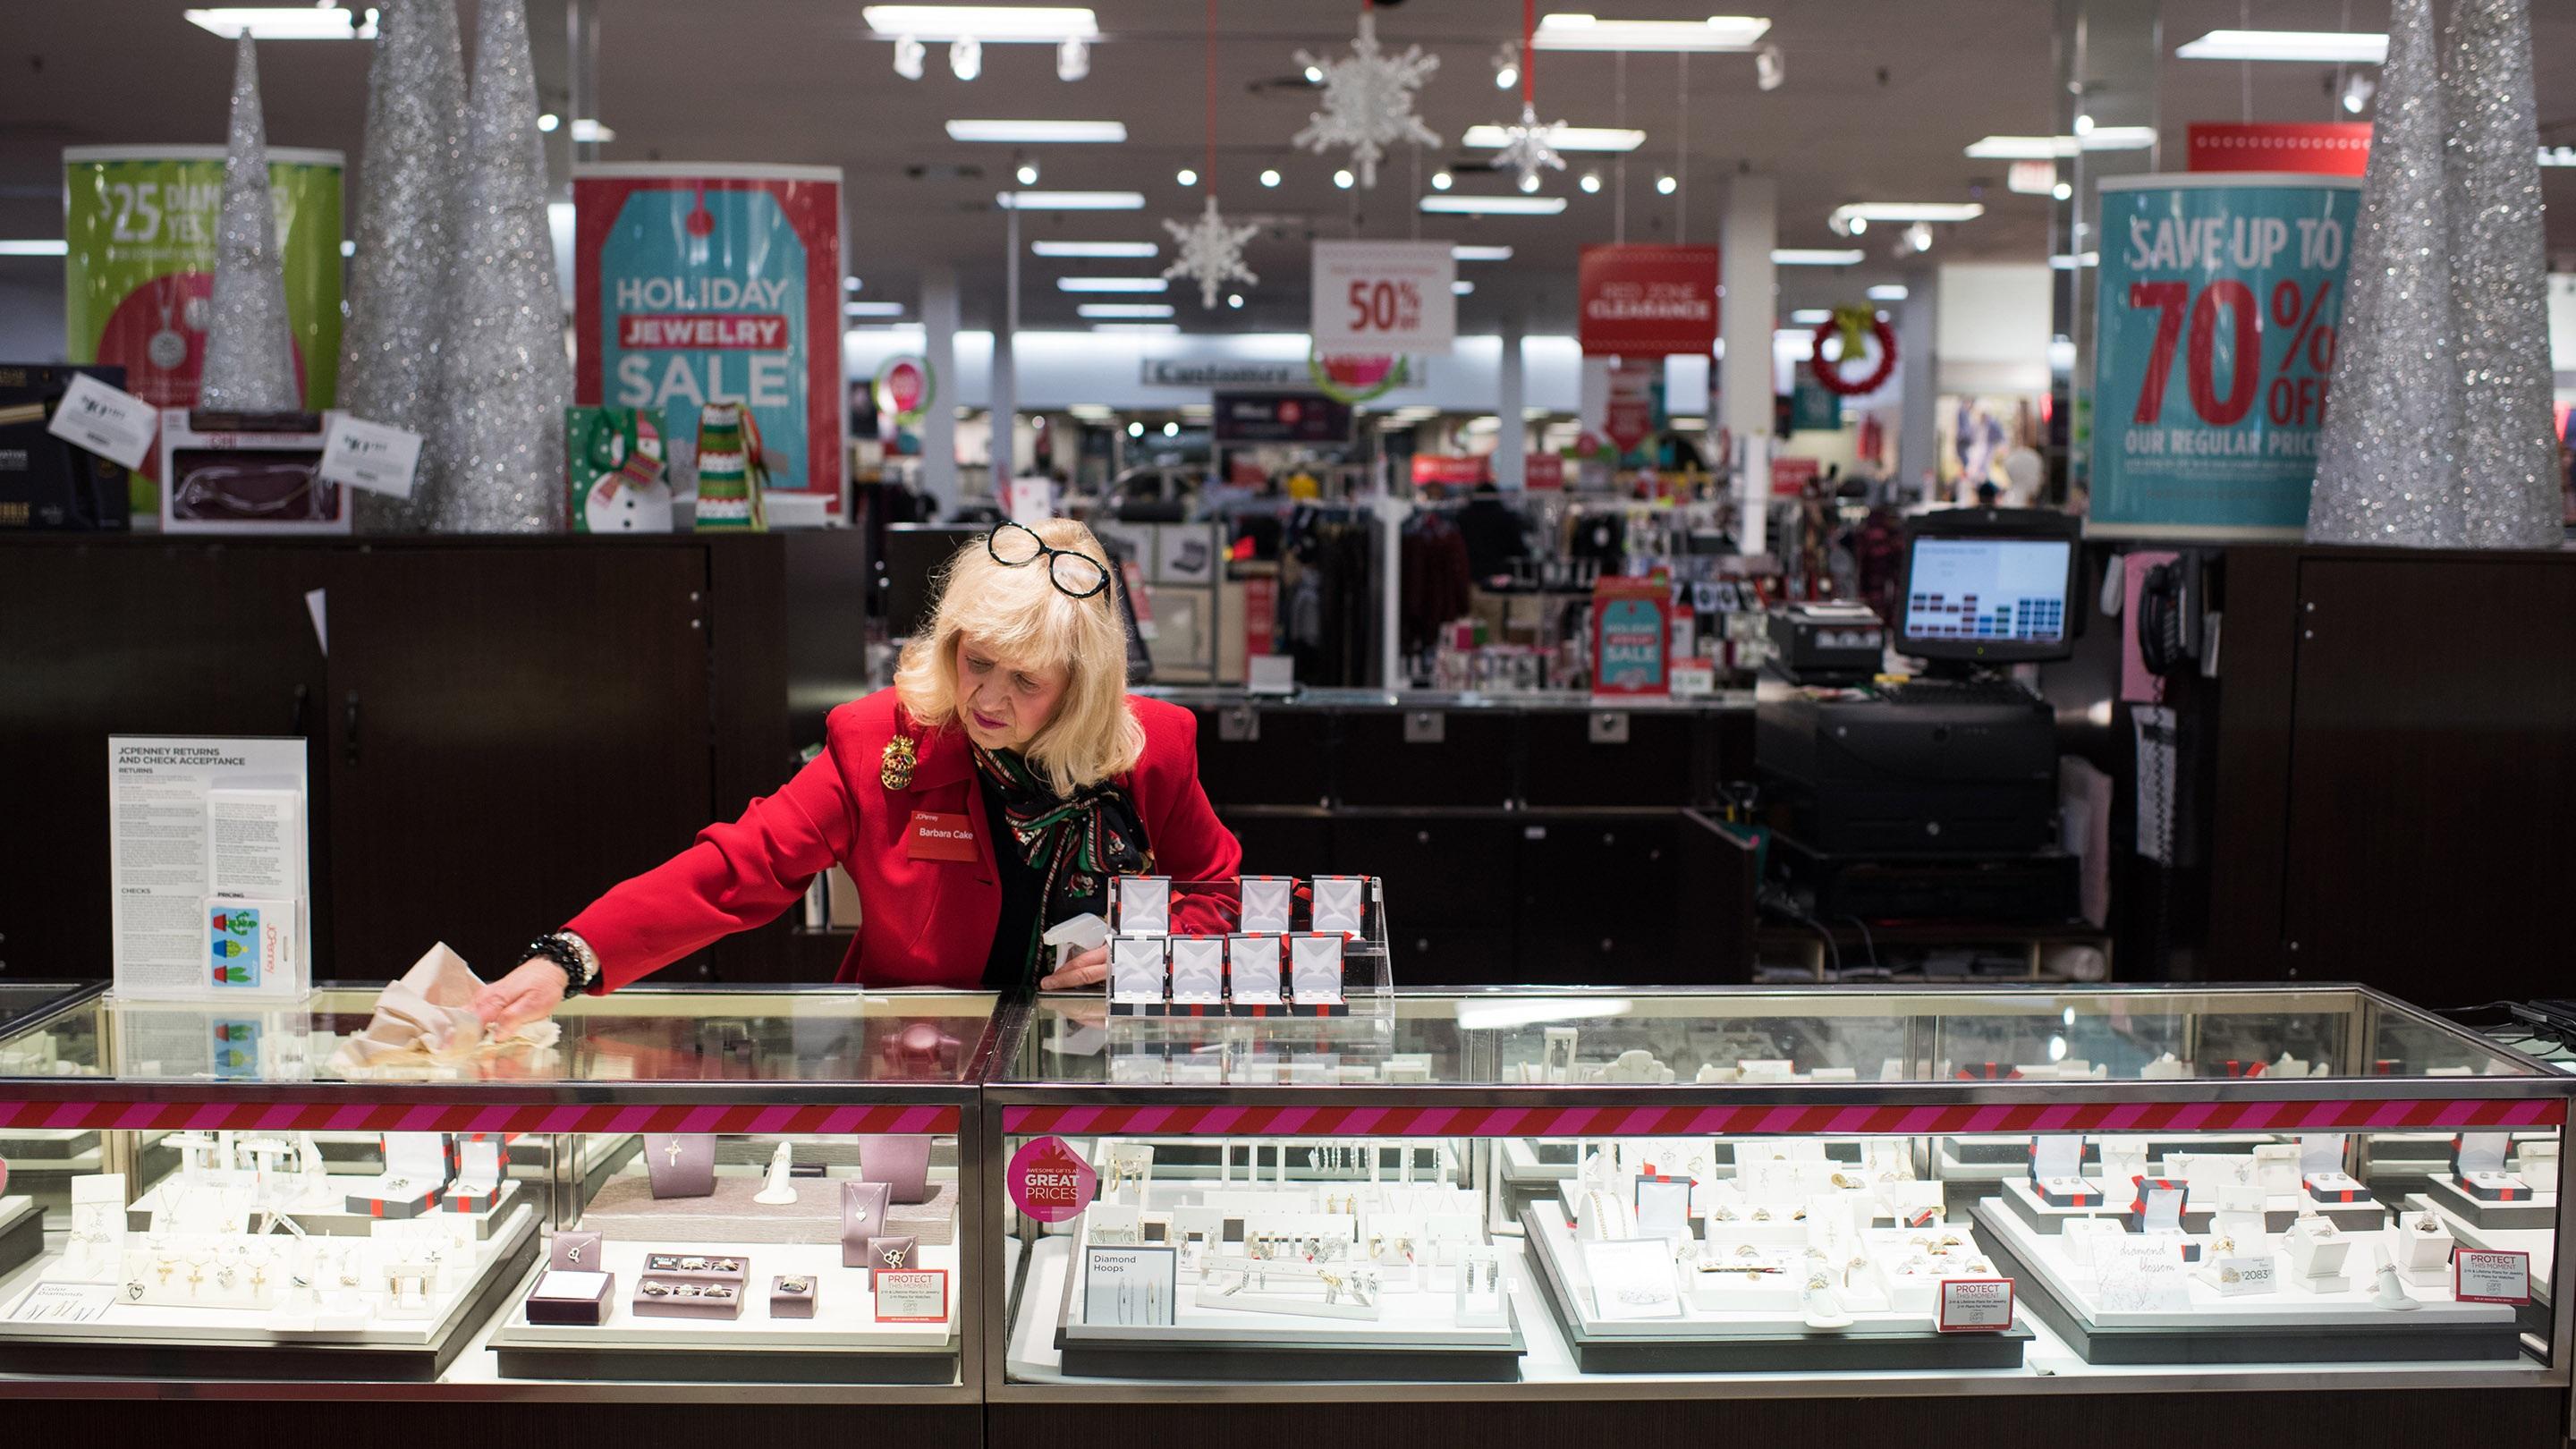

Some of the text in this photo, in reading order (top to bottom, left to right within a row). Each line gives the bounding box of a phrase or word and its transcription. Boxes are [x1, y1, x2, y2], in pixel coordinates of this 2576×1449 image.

[100, 182, 162, 242] $25
[2130, 217, 2342, 269] SAVE UP TO
[617, 277, 788, 309] HOLIDAY
[1348, 280, 1422, 332] 50%
[1588, 300, 1710, 320] CLEARANCE
[625, 318, 781, 344] JEWELRY
[2130, 279, 2336, 428] 70%
[617, 355, 789, 407] SALE
[2125, 429, 2165, 453] OUR
[2172, 429, 2261, 454] REGULAR
[118, 747, 220, 757] JCPENNEY RETURNS
[119, 756, 245, 767] AND CHECK ACCEPTANCE
[919, 827, 973, 840] Barbara Cake
[1024, 1174, 1080, 1187] GREAT
[1025, 1187, 1079, 1199] PRICES
[1094, 1255, 1136, 1263] Diamond
[2471, 1255, 2516, 1264] PROTECT
[1094, 1265, 1123, 1273] Hoops
[888, 1275, 933, 1283] PROTECT
